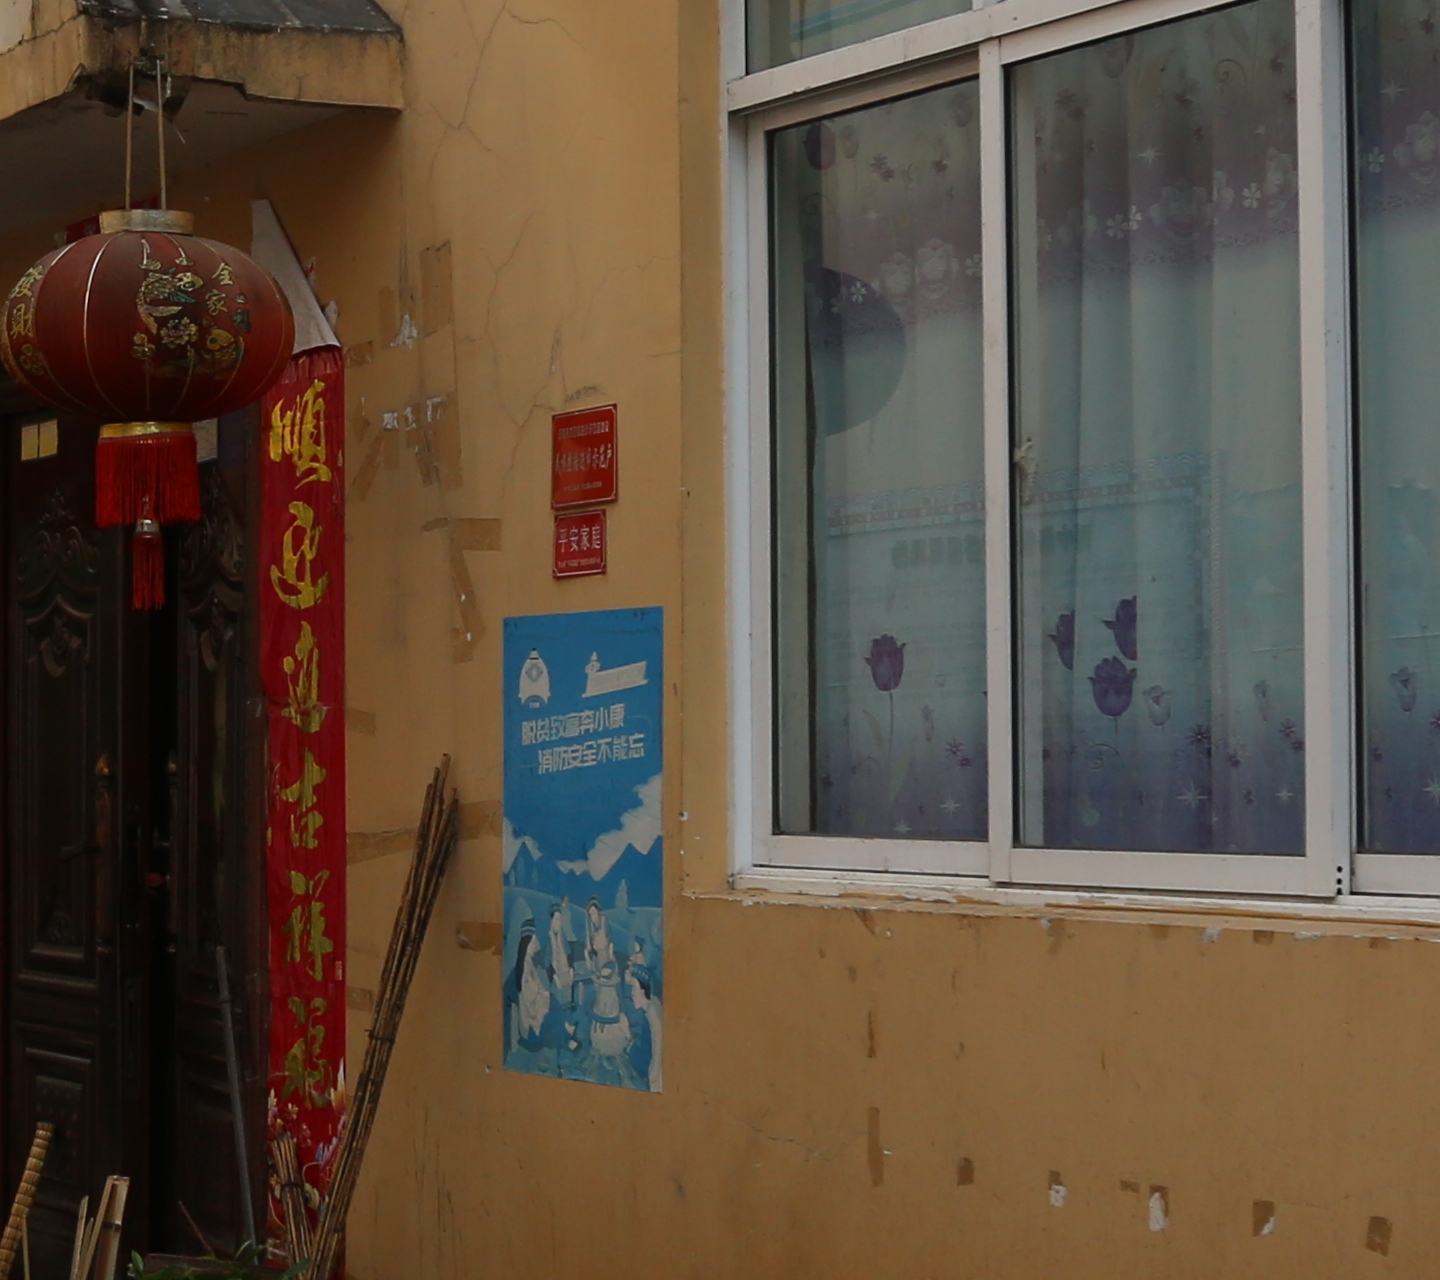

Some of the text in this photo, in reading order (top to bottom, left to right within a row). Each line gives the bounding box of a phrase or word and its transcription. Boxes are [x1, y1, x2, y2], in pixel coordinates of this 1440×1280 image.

[558, 524, 602, 553] 平安家庭
[521, 703, 625, 746] 脱贫致富奔小康
[538, 733, 645, 775] 消防安全不能忘
